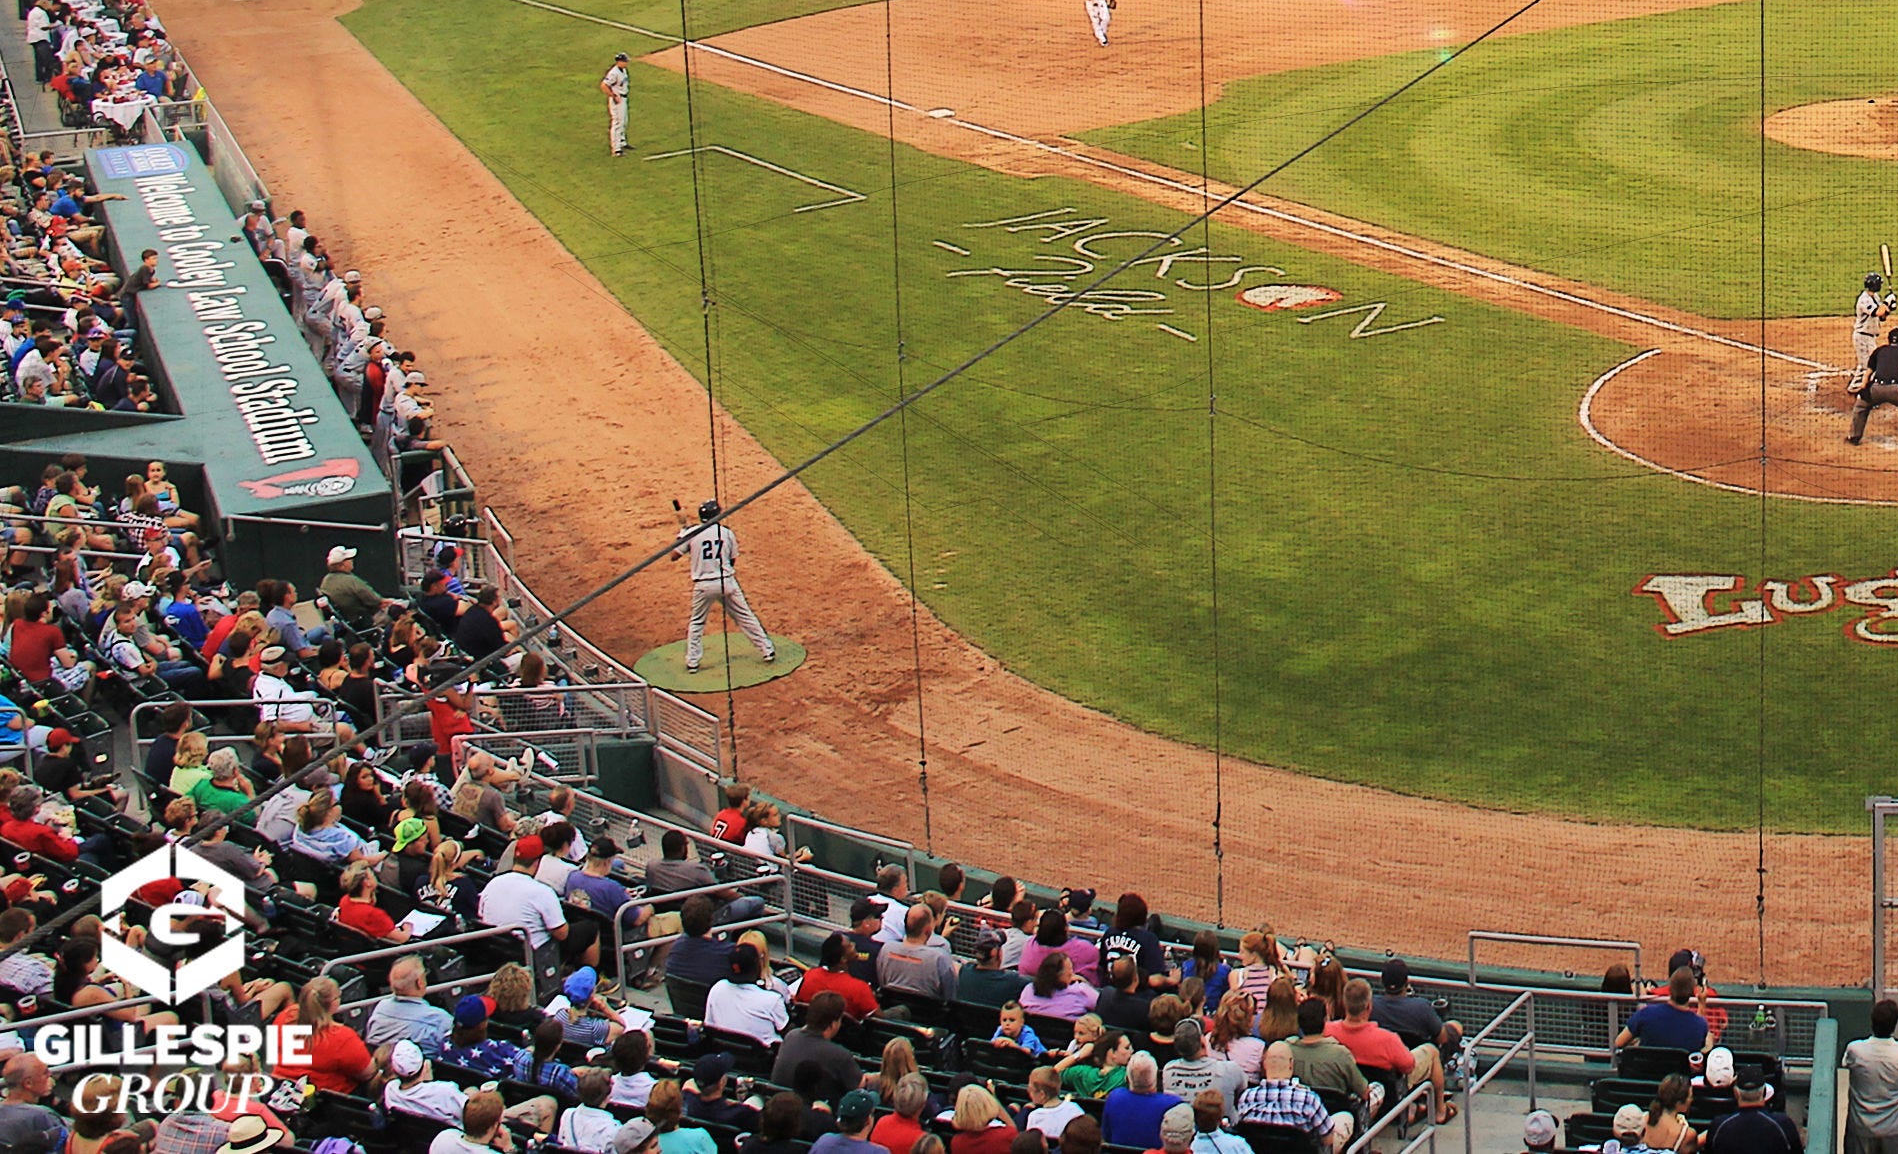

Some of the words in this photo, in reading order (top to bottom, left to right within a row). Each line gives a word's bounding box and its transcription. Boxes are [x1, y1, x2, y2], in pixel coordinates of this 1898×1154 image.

[134, 171, 197, 227] Welcome
[158, 224, 204, 243] to
[167, 241, 236, 289] Cooley
[187, 286, 247, 322] Law
[203, 320, 292, 382] School
[230, 377, 320, 466] Stadium
[702, 539, 724, 560] 27
[714, 819, 728, 839] 7
